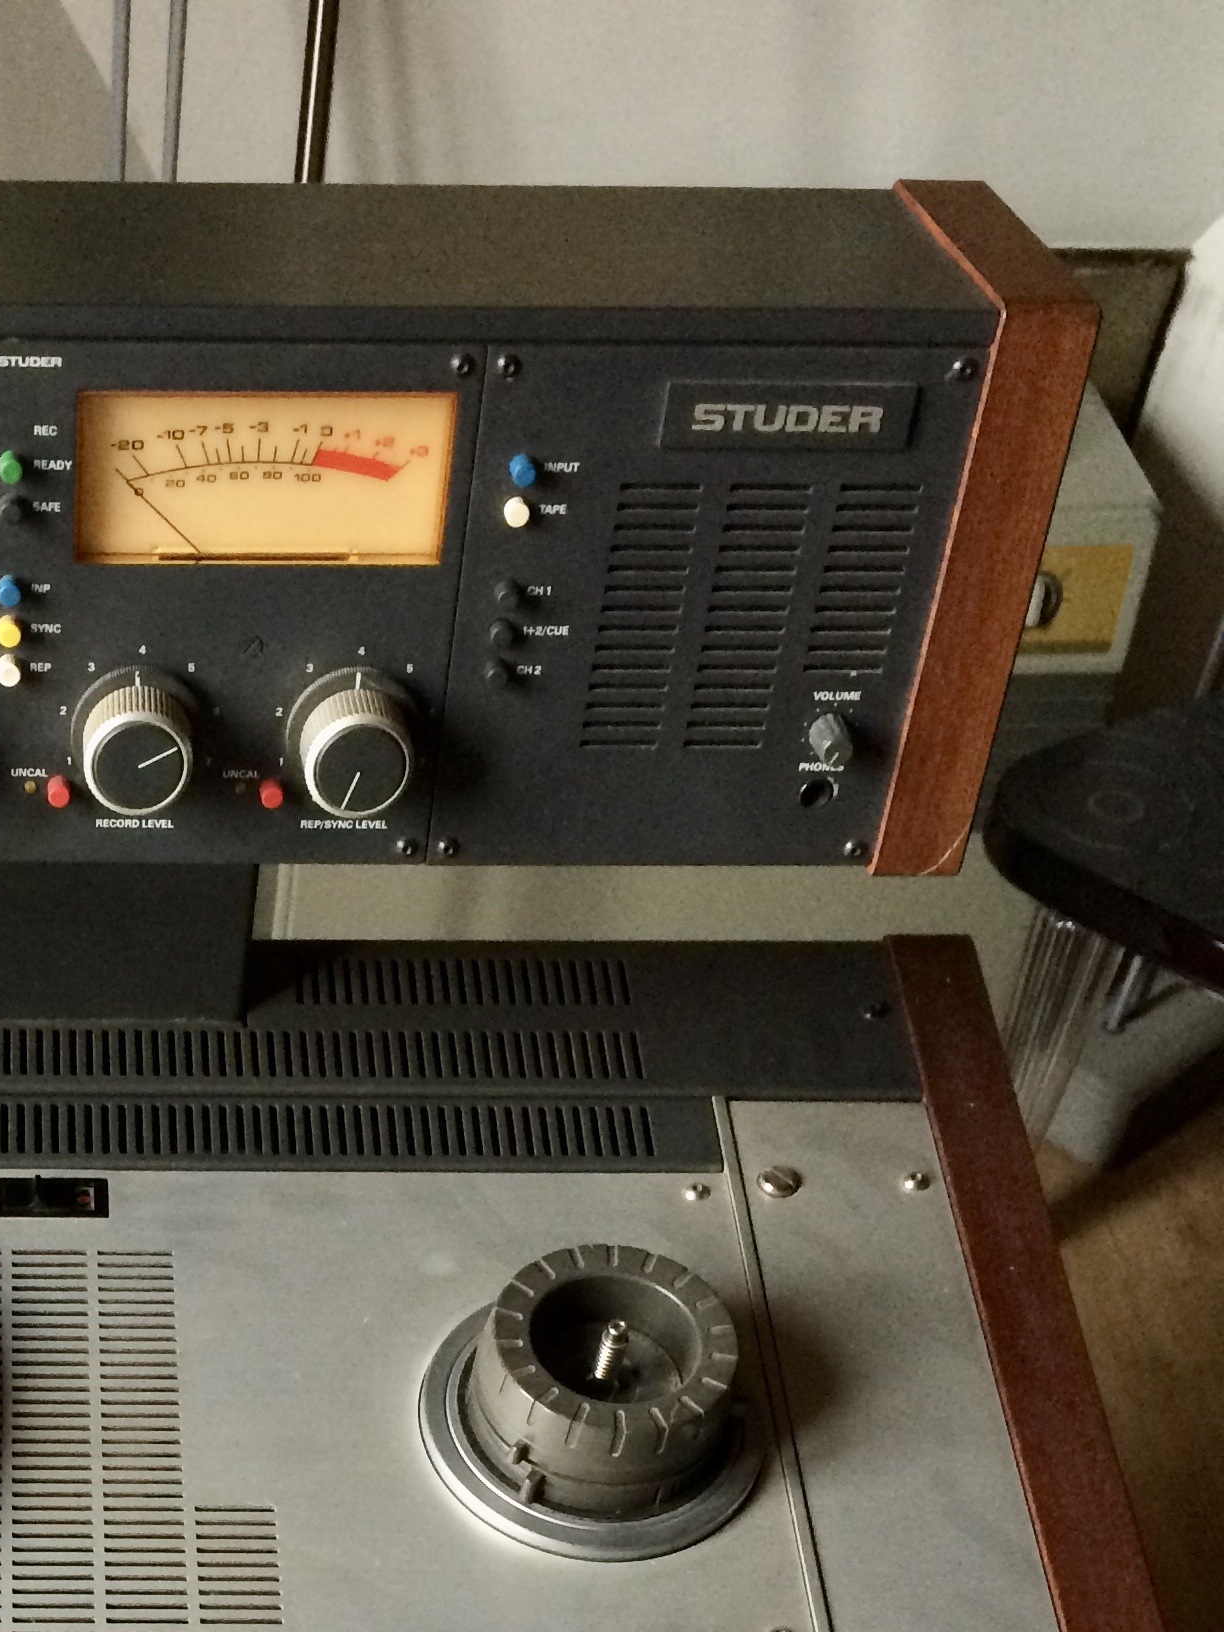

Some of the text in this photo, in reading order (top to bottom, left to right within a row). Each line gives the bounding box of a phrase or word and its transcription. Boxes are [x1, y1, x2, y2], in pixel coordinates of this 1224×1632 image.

[691, 404, 884, 433] STUDER
[33, 425, 58, 437] REC
[249, 421, 269, 433] -3
[33, 459, 73, 471] READY
[544, 461, 580, 473] INPUT
[293, 473, 322, 483] 100
[32, 502, 61, 513] SAFE
[539, 504, 568, 515] TAPE
[30, 624, 62, 636] SYNC
[138, 645, 147, 654] 4
[357, 646, 366, 656] 4
[29, 662, 53, 673] REP
[87, 662, 96, 672] 3
[813, 691, 862, 701] VOLUME
[59, 706, 67, 716] 2
[275, 707, 284, 717] 2
[10, 767, 49, 778] UNCAL
[222, 769, 260, 780] UNCAL
[95, 818, 174, 829] RECORD LEVEL
[300, 819, 388, 830] REP/SYNC LEVEL
